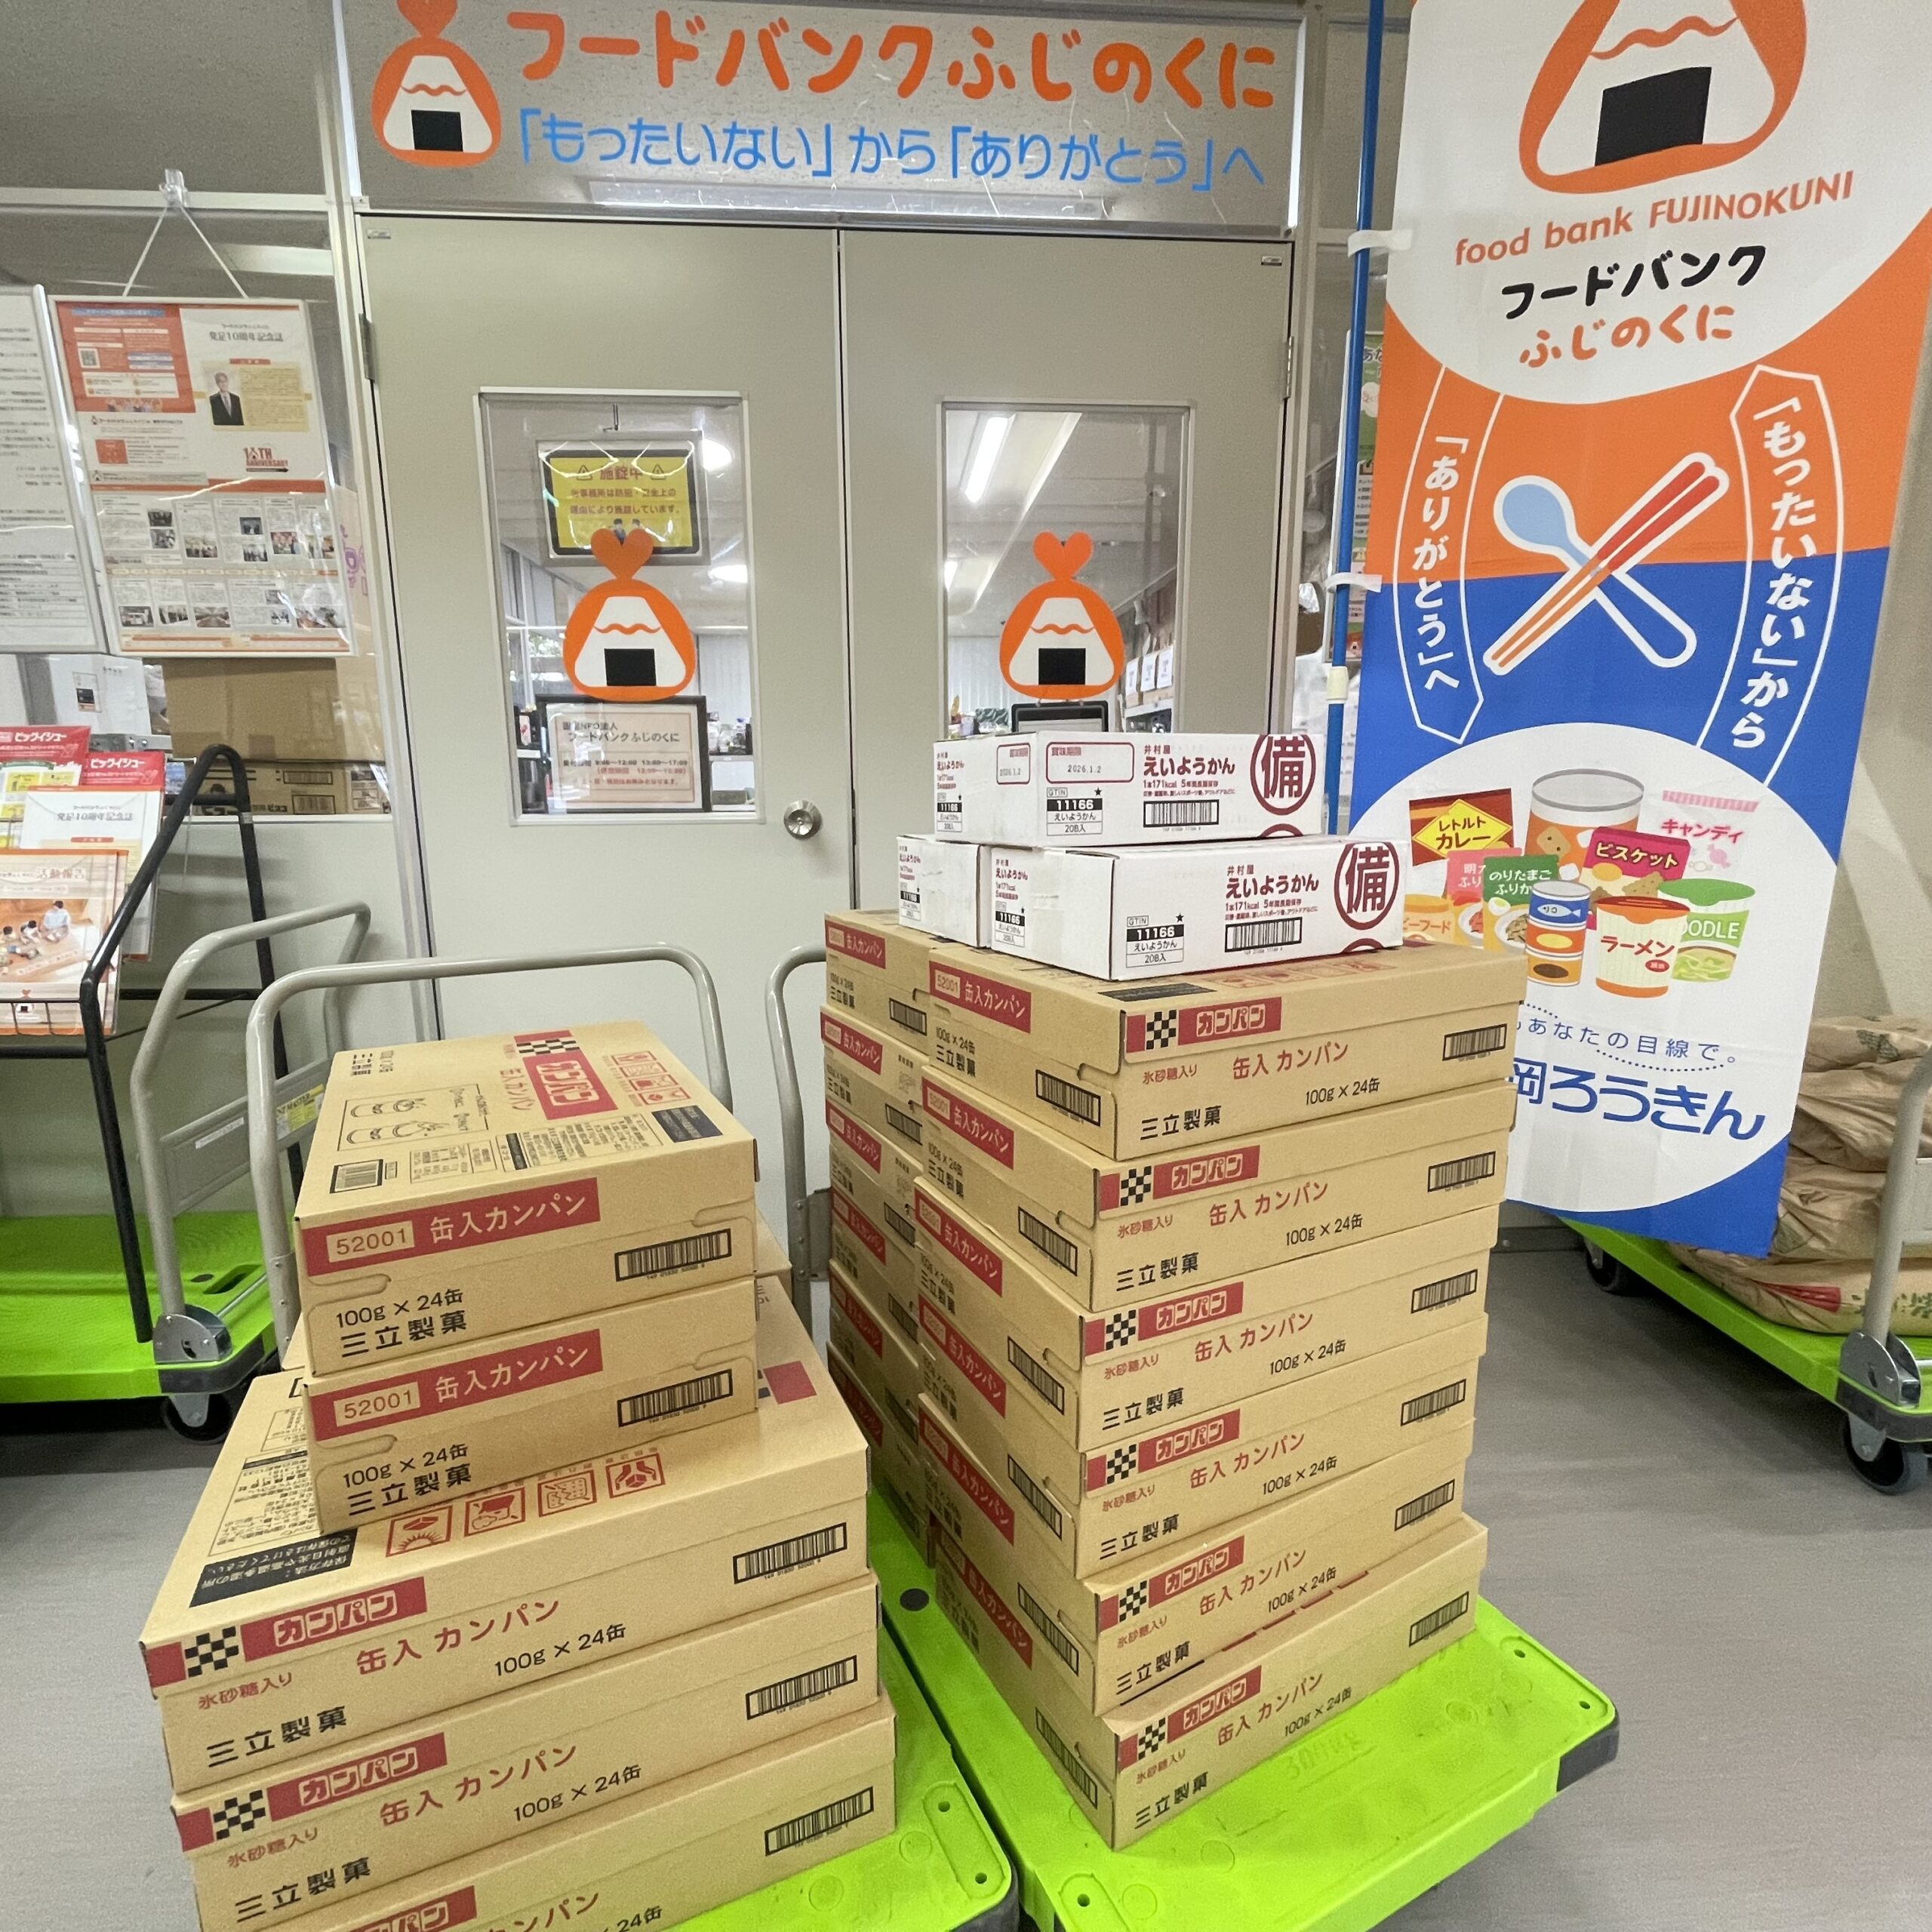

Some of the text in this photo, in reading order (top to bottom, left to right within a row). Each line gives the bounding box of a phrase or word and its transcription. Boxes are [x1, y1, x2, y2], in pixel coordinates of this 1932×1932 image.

[507, 11, 1275, 109] フードバンクふじのくに
[520, 108, 1265, 192] 「もったいない」から「ありがとう」へ
[1456, 171, 1854, 266] food bank FUJINOKUNI
[1501, 245, 1766, 319] フードバンク
[1519, 303, 1736, 368] ふじのくに
[600, 465, 642, 480] 施錠中
[1412, 435, 1469, 689] 「ありがとう」へ
[1732, 396, 1817, 749] 「もったいない」から
[14, 731, 66, 742] ビッグイシュー
[1143, 744, 1171, 755] 井村屋
[91, 758, 145, 769] ビッグイシュー
[1143, 757, 1235, 777] えいようかん
[1260, 735, 1306, 799] 備
[1054, 812, 1096, 821] えいようかん
[1056, 800, 1094, 811] 11166
[1438, 817, 1487, 833] レトルト
[1435, 832, 1492, 851] カレー
[1661, 818, 1744, 844] キャンディ
[1226, 865, 1254, 875] 井村屋
[1489, 869, 1552, 881] のりたまご
[1595, 841, 1678, 868] ビスケット
[1226, 873, 1319, 900] えいようかん
[1346, 844, 1391, 913] 備
[1134, 940, 1177, 952] えいようかん
[1137, 927, 1175, 940] 11166
[1601, 935, 1675, 957] ラーメン
[964, 981, 1026, 1018] 缶入カンパン
[1196, 1004, 1266, 1037] カンパン
[936, 1044, 977, 1078] 三立製菓
[1232, 1041, 1349, 1080] 缶入カンパン
[1517, 1017, 1737, 1064] あなたの目線で。
[953, 1106, 1009, 1153] 缶入カンパン
[1140, 1105, 1223, 1141] 三立製菓
[1171, 1153, 1243, 1190] カンパン
[336, 1192, 586, 1257] 52001 缶入カンパン
[1209, 1182, 1329, 1226] 缶入カンパン
[1116, 1251, 1200, 1292] 三立製菓
[340, 1309, 468, 1358] 三立製菓
[1156, 1291, 1227, 1331] カンパン
[1194, 1312, 1314, 1363] 缶入カンパン
[343, 1346, 589, 1420] 52001 缶入カンパン
[1102, 1386, 1184, 1431] 三立製菓
[1155, 1419, 1224, 1463] カンパン
[1190, 1432, 1305, 1489] 缶入カンパン
[347, 1463, 472, 1516] 三立製菓
[1100, 1513, 1179, 1560] 三立製菓
[1164, 1546, 1229, 1595] カンパン
[1199, 1549, 1307, 1616] 缶入カンパン
[274, 1590, 398, 1647] カンパン
[356, 1600, 559, 1675] 缶入カンパン
[198, 1670, 292, 1710] 氷砂糖入り
[1115, 1640, 1191, 1695] 三立製菓
[1183, 1678, 1247, 1730] カンパン
[1217, 1673, 1324, 1747] 缶入カンパン
[207, 1705, 347, 1767] 三立製菓
[299, 1746, 418, 1806] カンパン
[379, 1745, 577, 1826] 缶入カンパン
[1134, 1771, 1209, 1829] 三立製菓
[228, 1826, 318, 1869] 氷砂糖入り
[235, 1857, 371, 1922] 三立製菓
